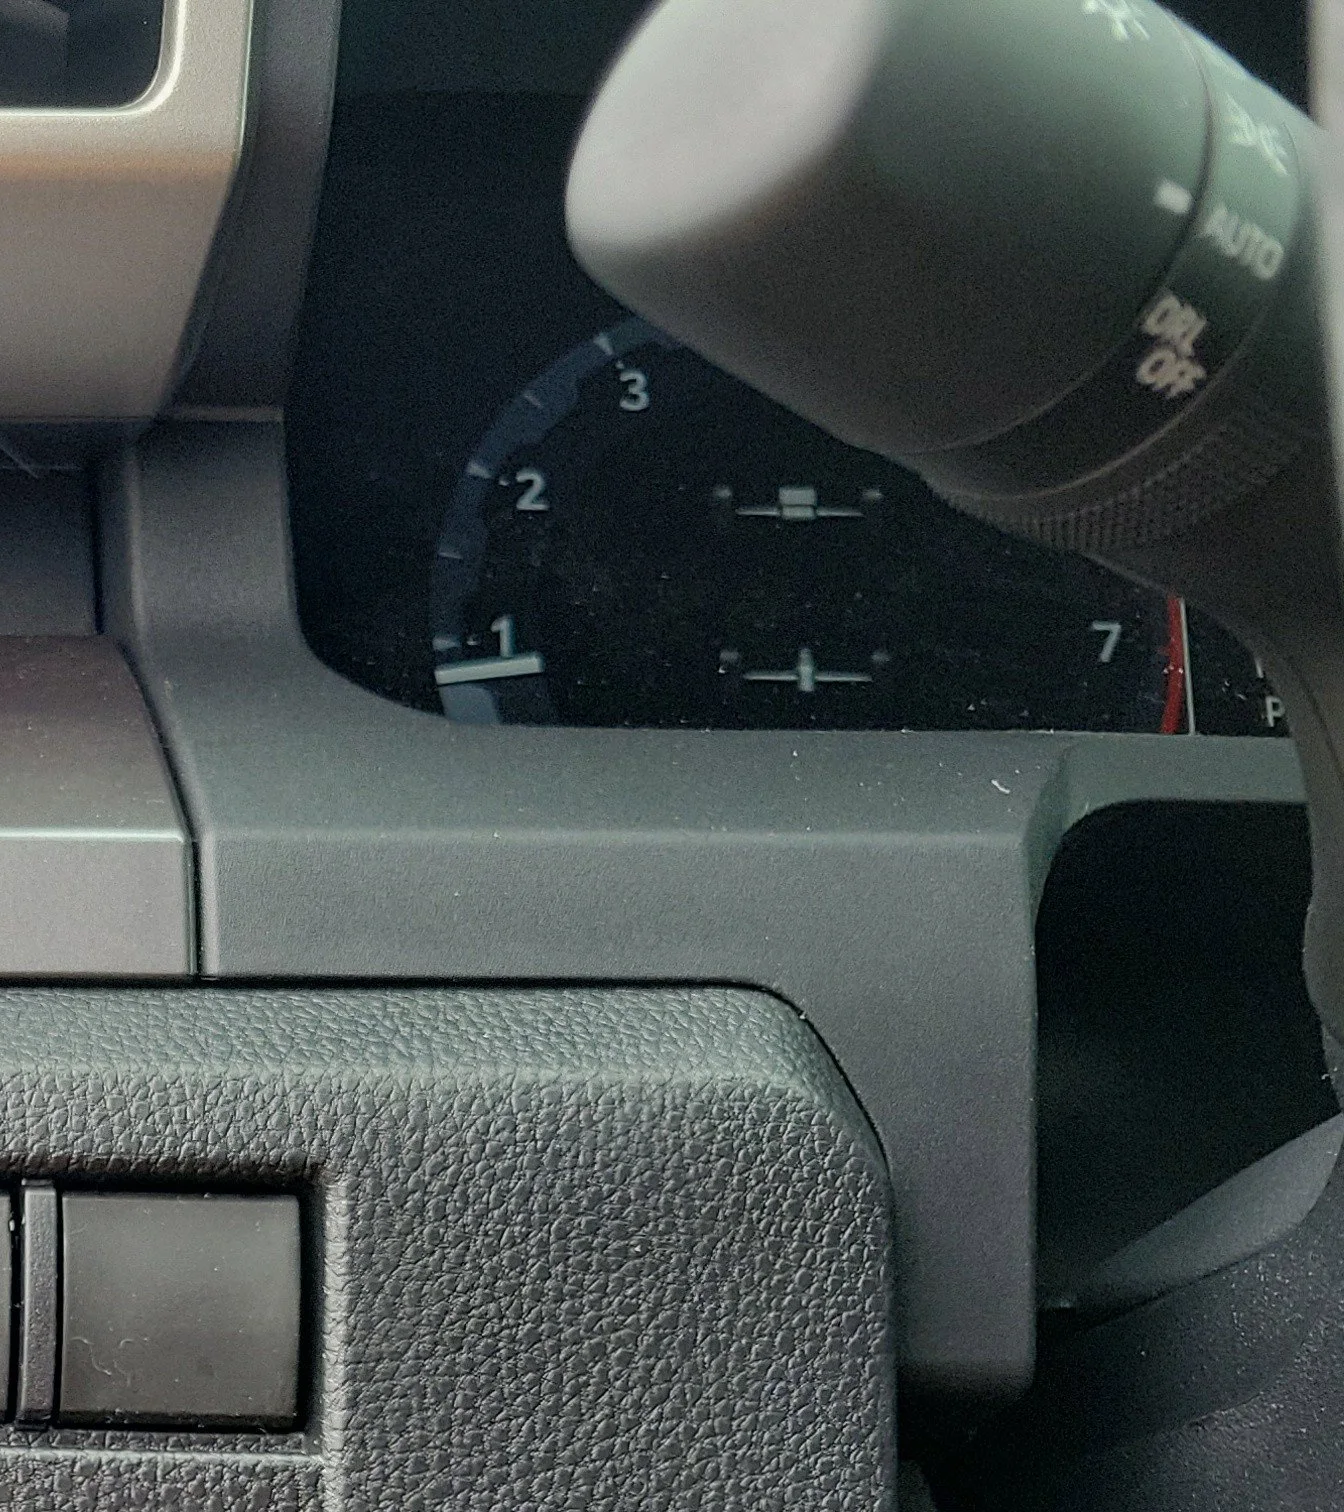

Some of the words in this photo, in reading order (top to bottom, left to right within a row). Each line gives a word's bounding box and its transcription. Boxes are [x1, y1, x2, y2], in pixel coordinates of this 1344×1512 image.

[1202, 203, 1285, 280] AUTO
[619, 369, 650, 411] 3
[1135, 348, 1207, 398] OFF
[515, 467, 550, 511] 2
[491, 614, 515, 658] 1
[1091, 620, 1123, 663] 7
